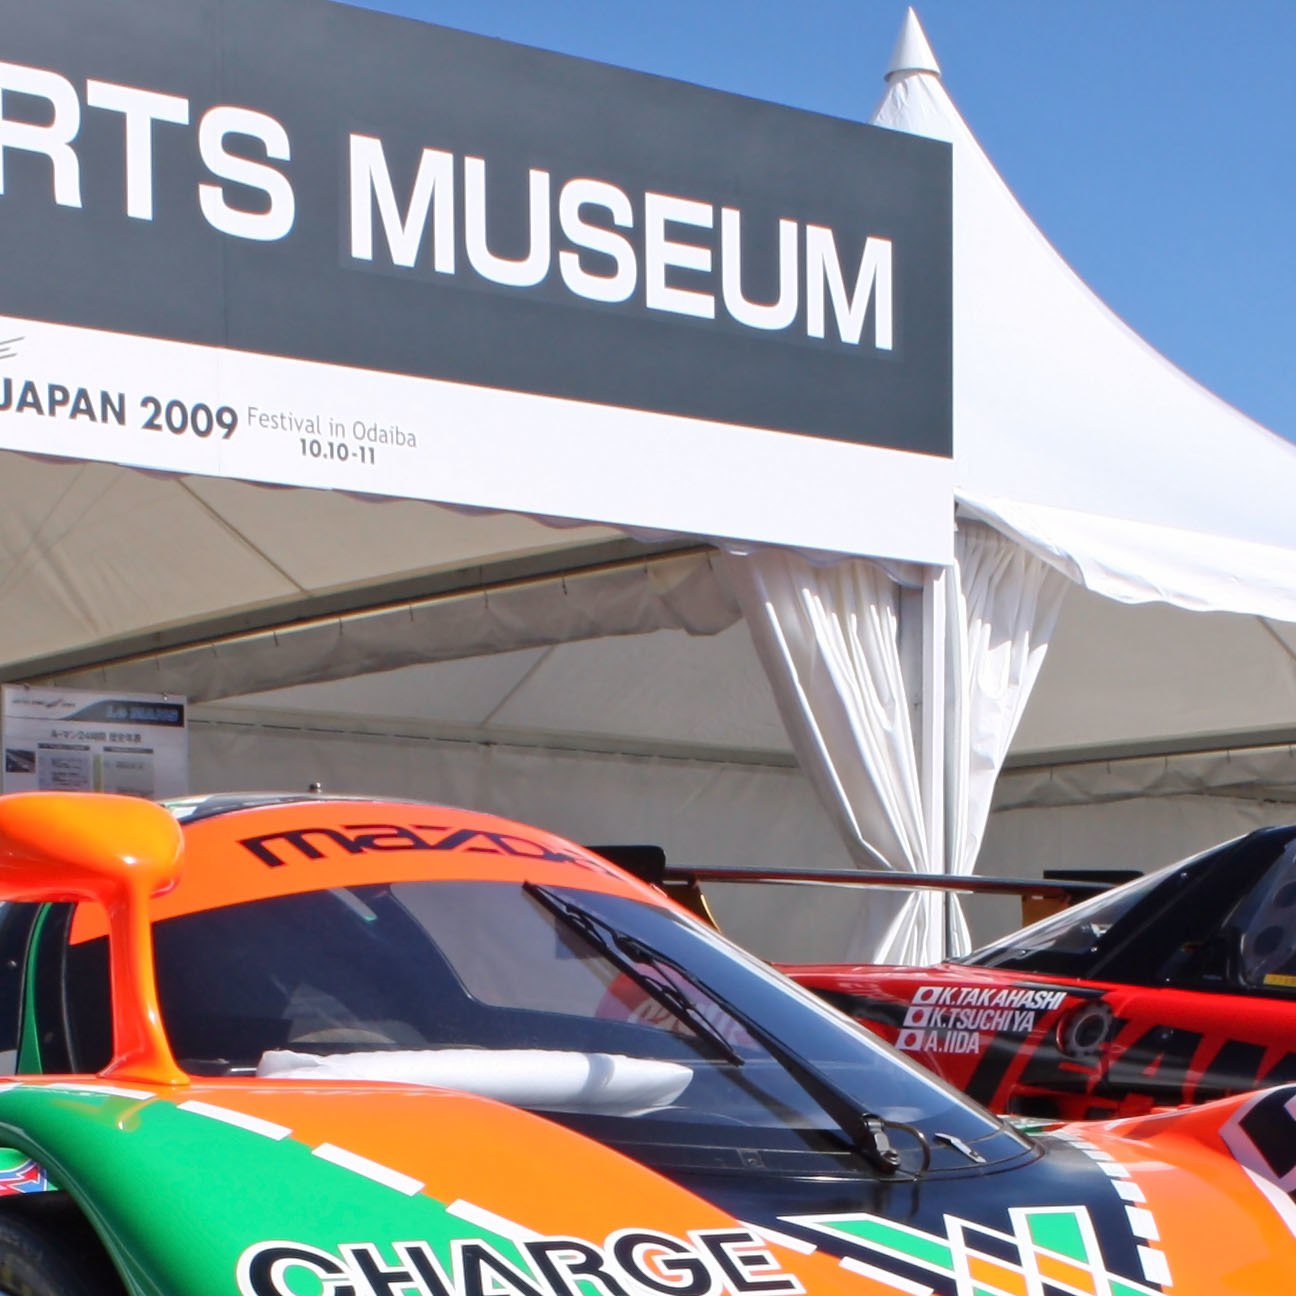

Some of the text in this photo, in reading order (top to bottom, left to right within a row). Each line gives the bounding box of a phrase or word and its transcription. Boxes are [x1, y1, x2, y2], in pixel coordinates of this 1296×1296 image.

[348, 132, 893, 351] MUSEUM
[139, 396, 239, 440] 2009
[247, 406, 418, 448] Festival in Odaiba
[299, 437, 376, 465] 10.10-11
[937, 987, 1067, 1011] K.TAKAHASHI
[929, 1008, 1037, 1032] K.TSUCHIYA
[923, 1030, 981, 1054] A.IIDA
